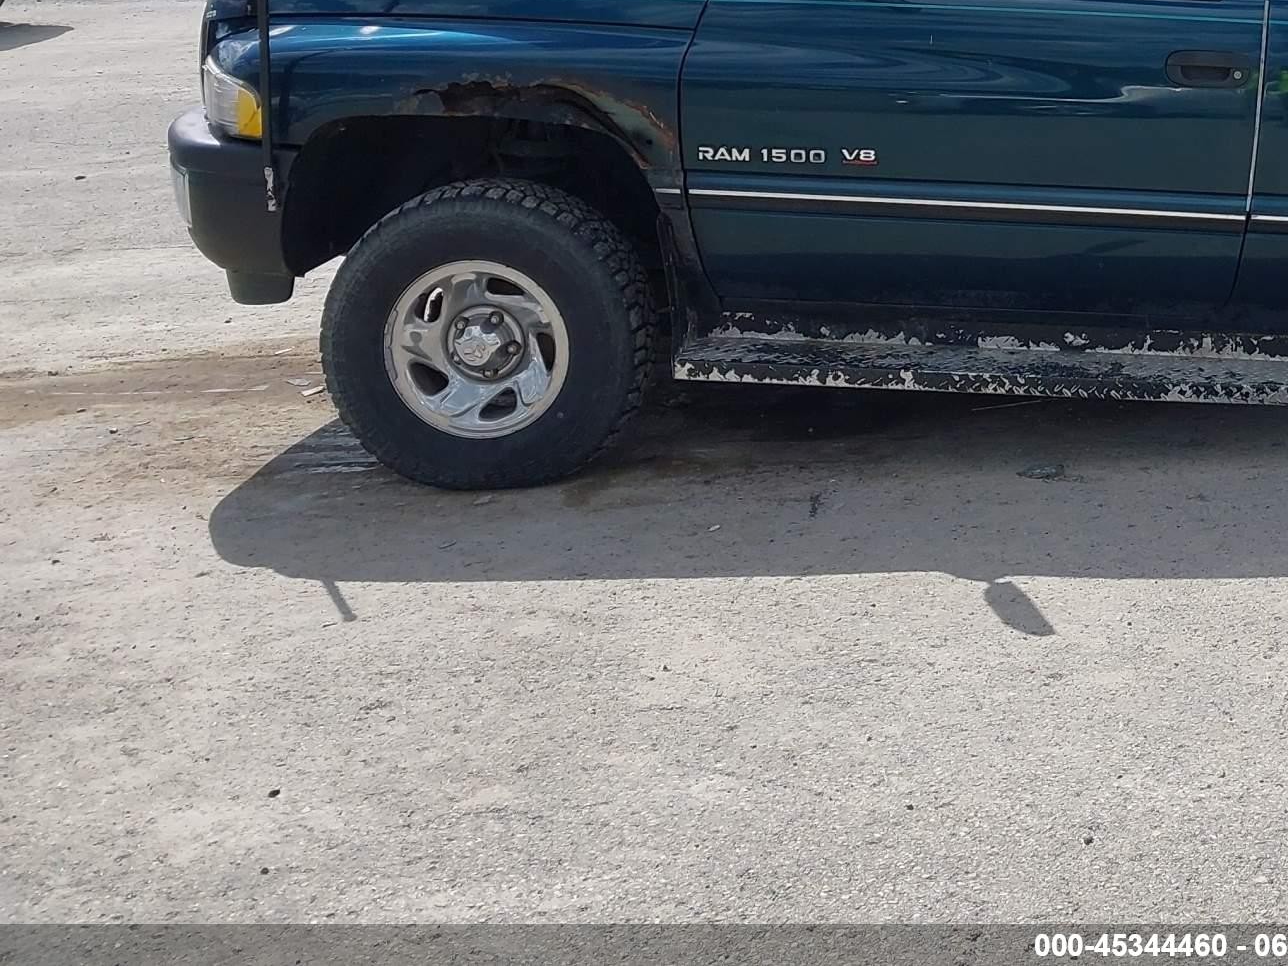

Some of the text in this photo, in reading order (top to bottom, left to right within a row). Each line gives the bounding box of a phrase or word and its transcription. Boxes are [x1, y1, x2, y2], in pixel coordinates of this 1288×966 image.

[698, 146, 877, 162] RAM 1500 V8
